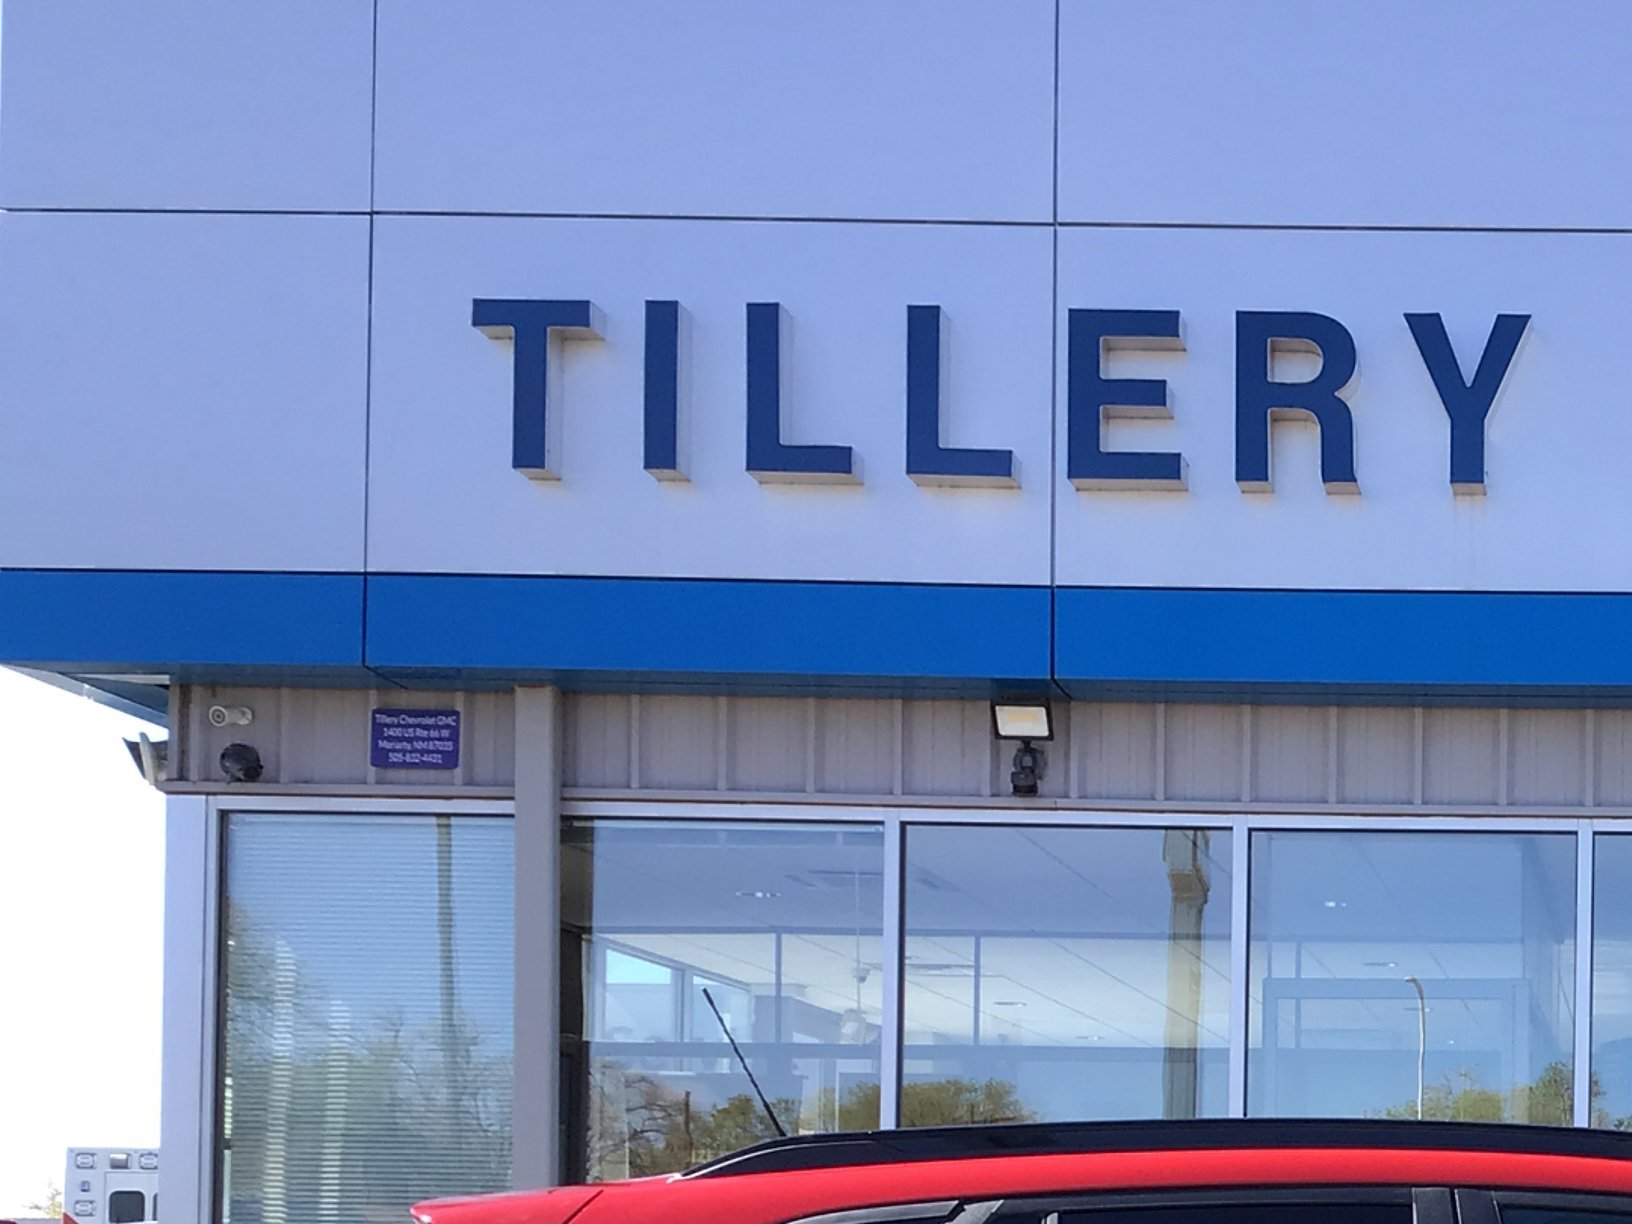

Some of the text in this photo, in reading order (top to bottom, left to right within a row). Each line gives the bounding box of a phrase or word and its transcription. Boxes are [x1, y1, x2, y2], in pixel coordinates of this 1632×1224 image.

[472, 297, 1531, 492] TILLERY
[375, 714, 457, 726] Tillery Chevrolet GMC
[440, 729, 450, 738] W
[413, 740, 428, 749] NM
